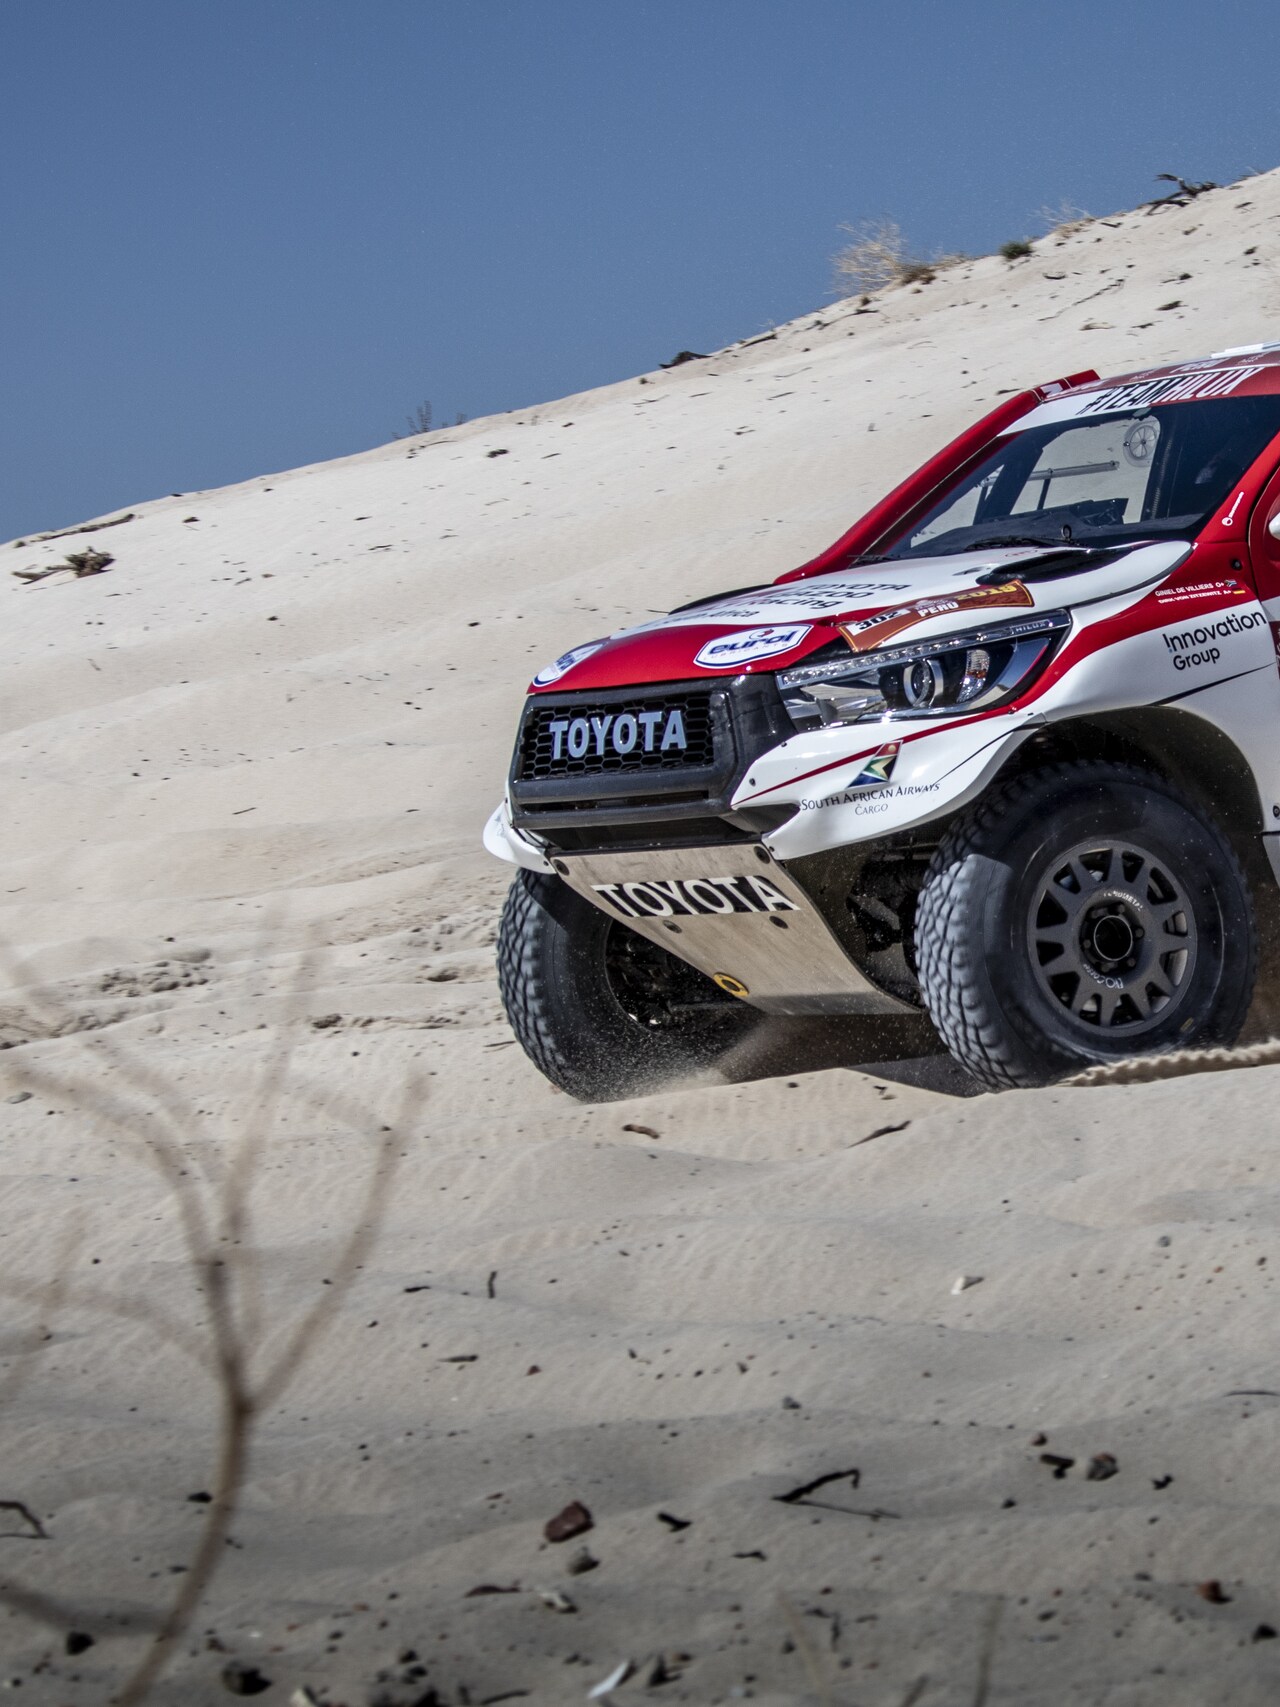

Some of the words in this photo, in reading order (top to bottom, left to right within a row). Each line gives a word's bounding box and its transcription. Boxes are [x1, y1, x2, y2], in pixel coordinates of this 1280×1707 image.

[1186, 583, 1214, 592] VILLIERS
[855, 611, 899, 630] 302
[708, 630, 799, 655] eurol
[1173, 647, 1221, 671] Group
[549, 710, 688, 760] TOYOTA
[801, 796, 842, 811] SOUTH
[843, 788, 893, 804] AFRICAN
[895, 783, 940, 797] AIRWAYS
[855, 804, 889, 815] CARGO
[590, 875, 800, 918] TOYOTA
